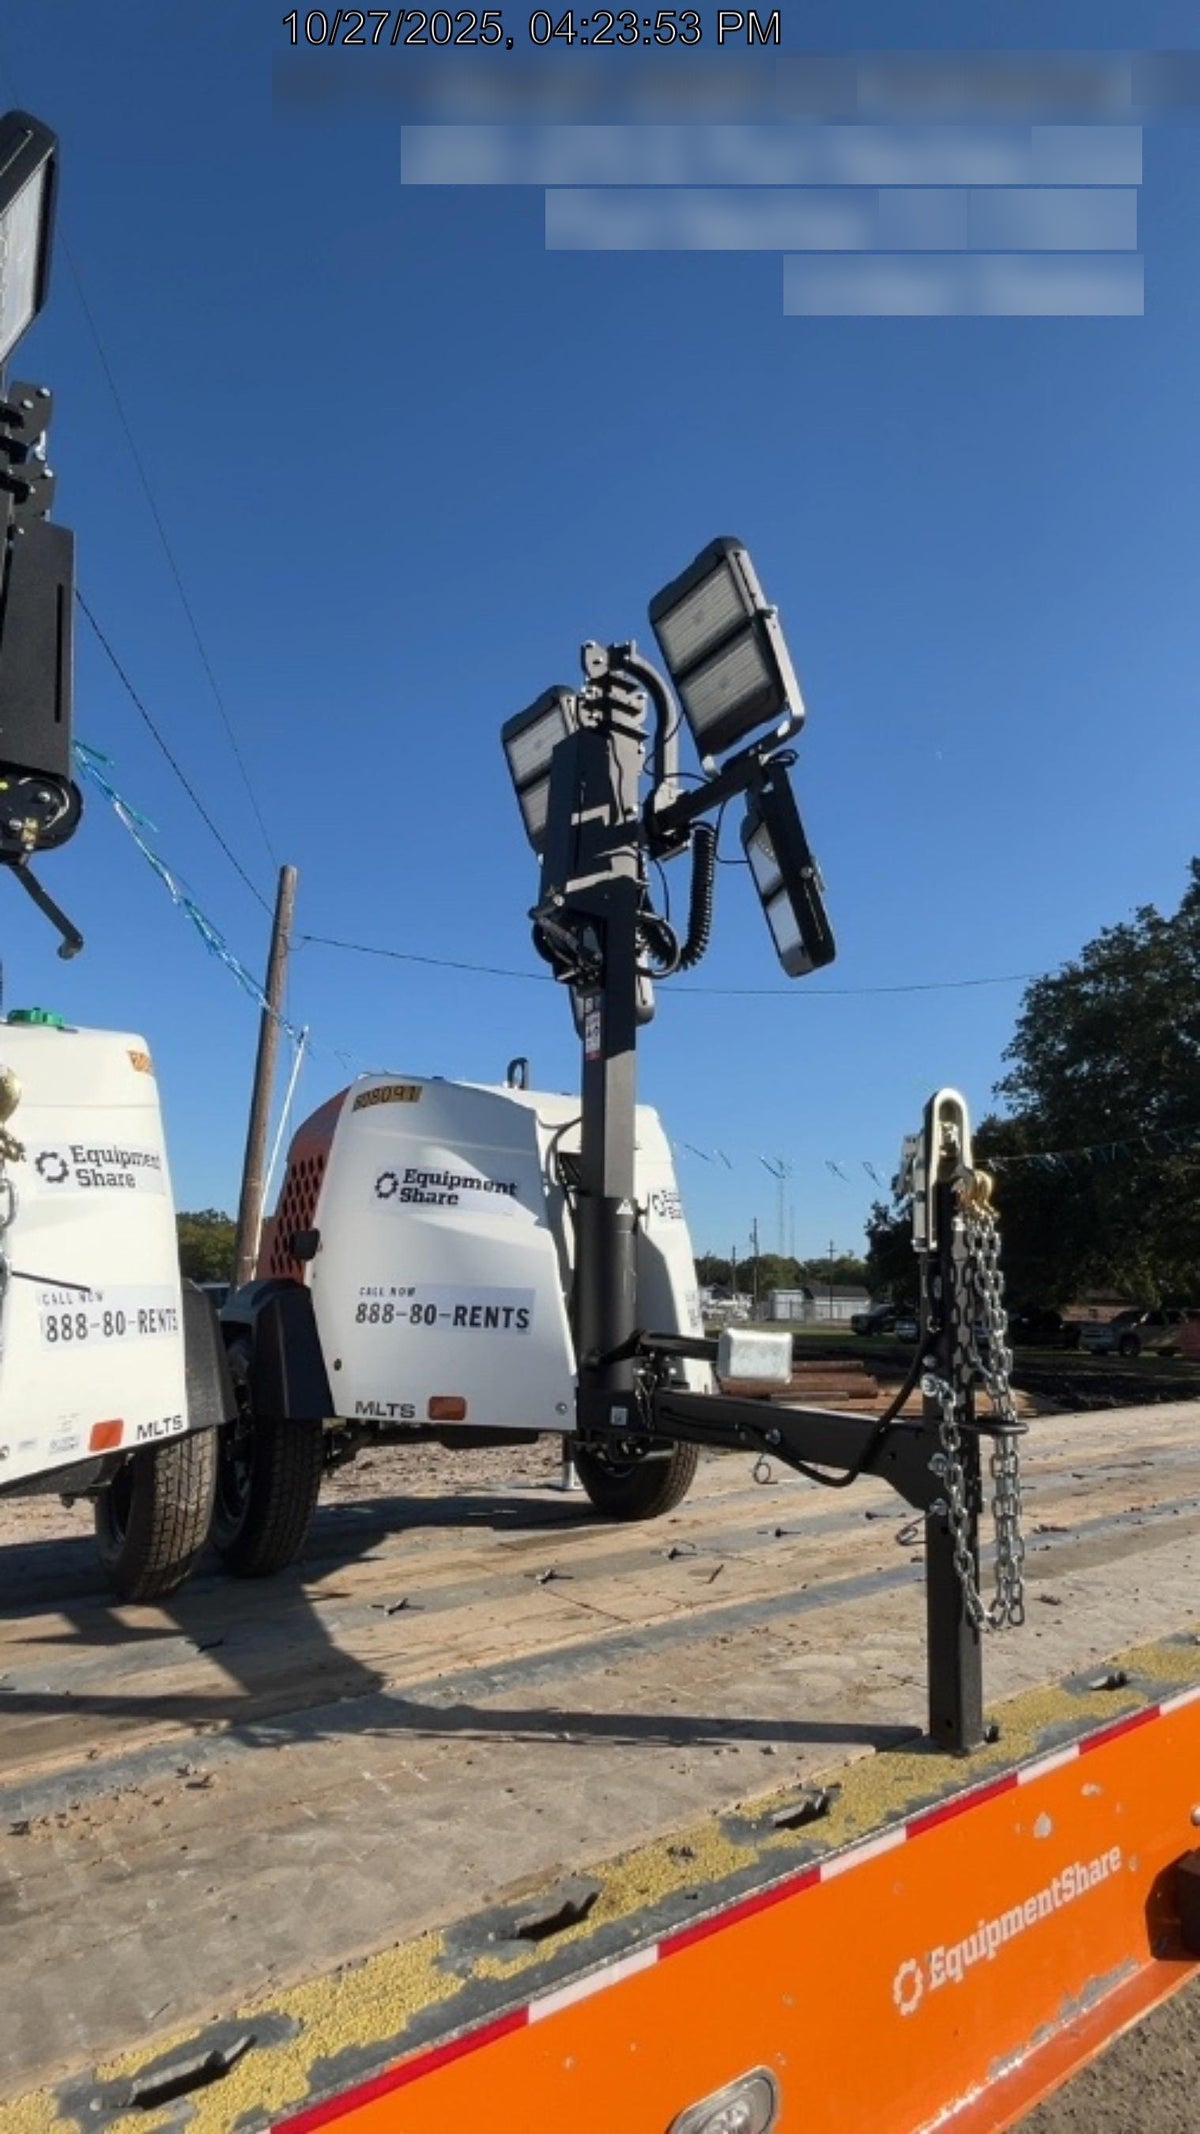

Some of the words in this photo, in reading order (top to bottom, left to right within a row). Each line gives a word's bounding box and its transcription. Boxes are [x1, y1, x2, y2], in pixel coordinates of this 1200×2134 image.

[76, 1168, 136, 1188] Share
[403, 1168, 518, 1196] Equipment
[400, 1187, 459, 1205] Share
[391, 1287, 416, 1298] NOW
[46, 1308, 178, 1342] 888-80-RENTS
[355, 1303, 530, 1329] 888-80-RENTS
[355, 1401, 416, 1418] MLTS
[137, 1414, 183, 1440] MLTS
[929, 1846, 1121, 1992] EquipmentShare
